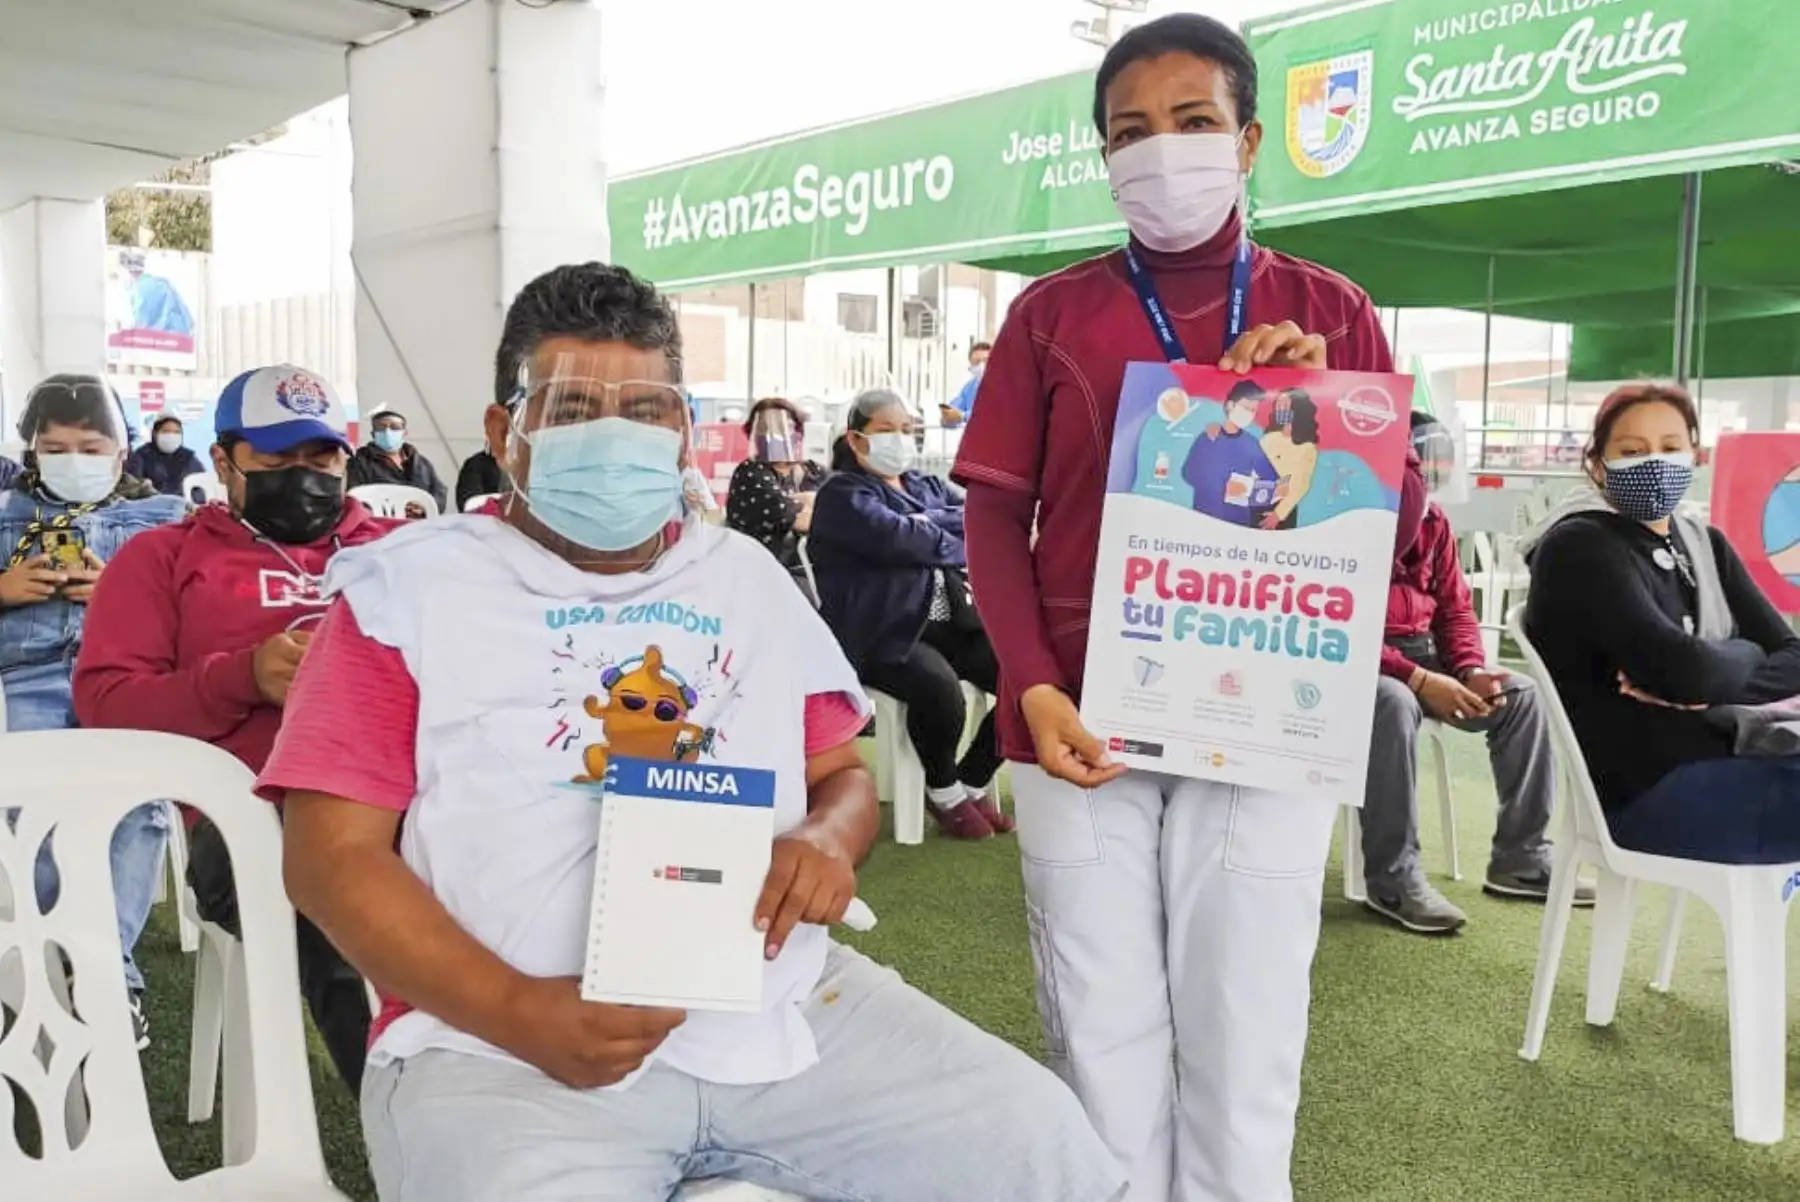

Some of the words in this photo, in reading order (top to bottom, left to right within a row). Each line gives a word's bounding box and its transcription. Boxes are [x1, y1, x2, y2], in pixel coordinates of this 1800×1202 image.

[1414, 0, 1622, 46] MUNICIPALID
[1394, 44, 1534, 108] Santa
[1537, 10, 1688, 92] Anita
[1002, 131, 1064, 166] Jose
[1068, 119, 1104, 153] Lu
[1409, 115, 1520, 154] AVANZA
[1531, 92, 1660, 135] SEGURO
[1040, 156, 1110, 191] ALCAL
[643, 154, 954, 250] #AvanzaSeguro
[1127, 534, 1148, 551] En
[1153, 537, 1222, 560] tiempos
[1226, 543, 1248, 562] de
[1254, 548, 1269, 564] la
[1274, 550, 1358, 574] COVID-19
[1122, 597, 1164, 628] tu
[1124, 557, 1354, 622] Planifica
[546, 606, 606, 630] USA
[646, 766, 740, 796] MINSA
